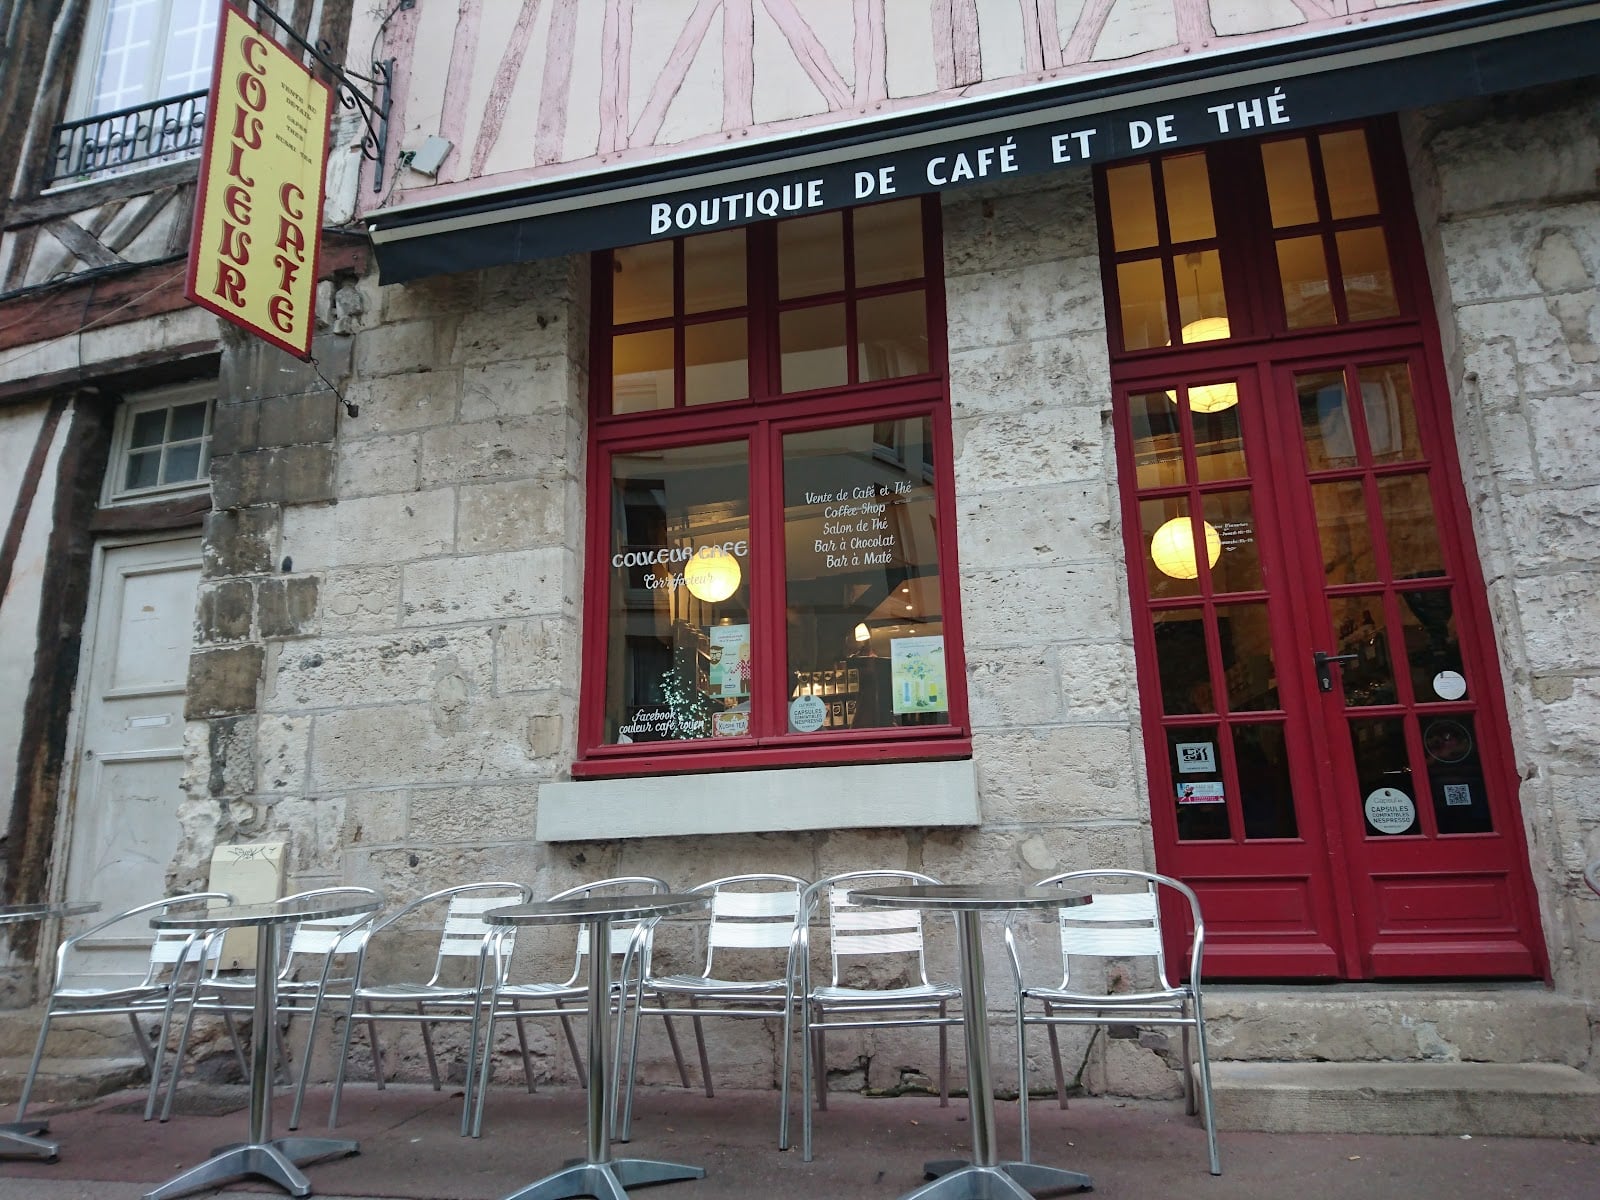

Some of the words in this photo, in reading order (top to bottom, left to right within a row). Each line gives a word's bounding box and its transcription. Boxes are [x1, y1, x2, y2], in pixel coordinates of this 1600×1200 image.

[281, 81, 304, 104] VENTE
[650, 179, 824, 235] BOUTIQUE
[854, 166, 896, 199] DE
[926, 135, 1019, 186] CAFÉ
[1051, 129, 1097, 163] ET
[1128, 114, 1178, 150] DE
[1206, 86, 1291, 133] THÉ
[804, 492, 833, 504] Vente
[836, 489, 848, 501] de
[852, 485, 876, 500] Café
[879, 485, 890, 497] et
[894, 481, 912, 494] Thé
[824, 504, 858, 518] Coffee
[861, 502, 886, 516] Shop
[823, 521, 854, 535] Salon
[856, 520, 869, 532] de
[871, 517, 888, 530] Thé
[814, 540, 837, 552] Bar
[840, 537, 848, 550] à
[850, 534, 896, 549] Chocolat
[612, 547, 694, 567] COULEUR
[698, 541, 748, 560] CAFE
[826, 554, 848, 568] Bar
[851, 552, 860, 566] à
[863, 549, 892, 565] Maté
[793, 708, 823, 716] CAPSULES
[619, 721, 654, 734] couleur
[655, 719, 676, 737] café
[1371, 805, 1409, 813] CAPSULES
